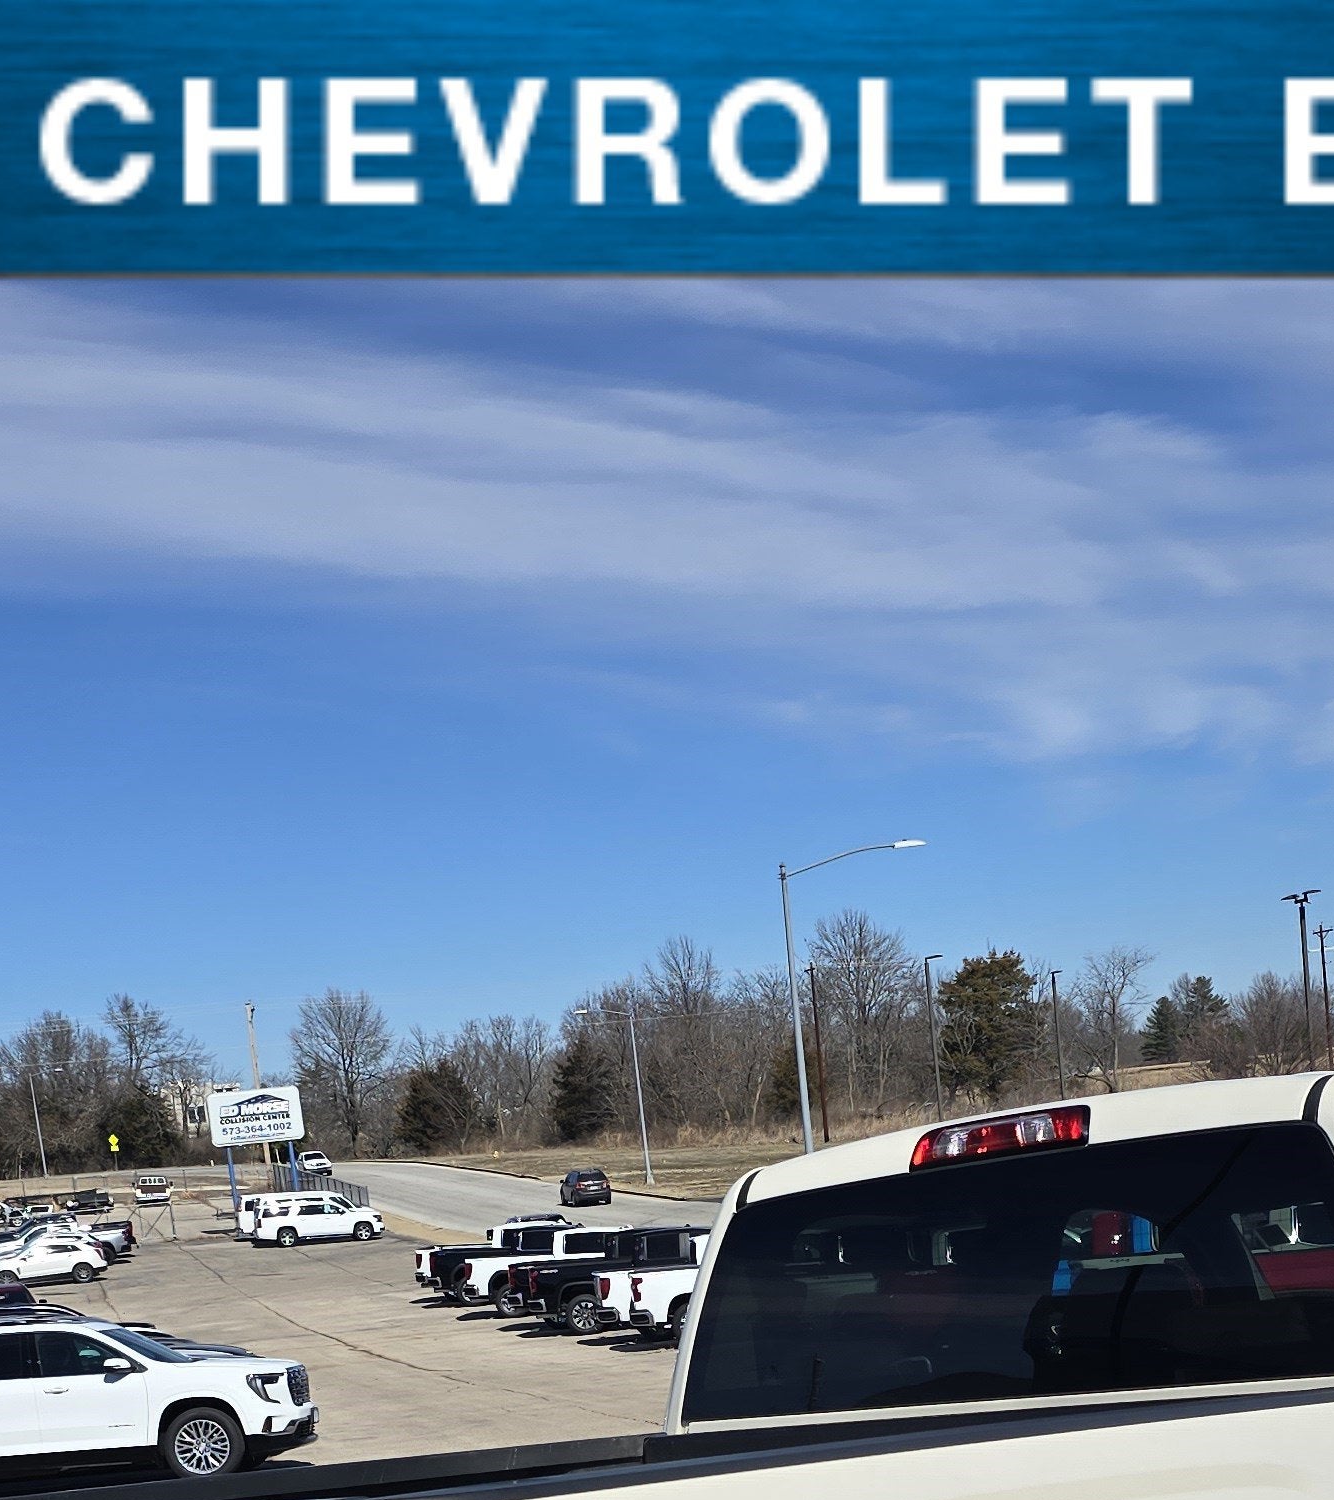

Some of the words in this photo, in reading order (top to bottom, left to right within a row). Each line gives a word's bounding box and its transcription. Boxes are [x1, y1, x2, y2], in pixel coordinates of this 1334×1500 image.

[219, 1105, 239, 1118] ED
[241, 1099, 289, 1116] MORSE
[219, 1116, 261, 1125] COLLISION
[262, 1113, 291, 1121] CENTER
[222, 1122, 292, 1136] 573-364-1002
